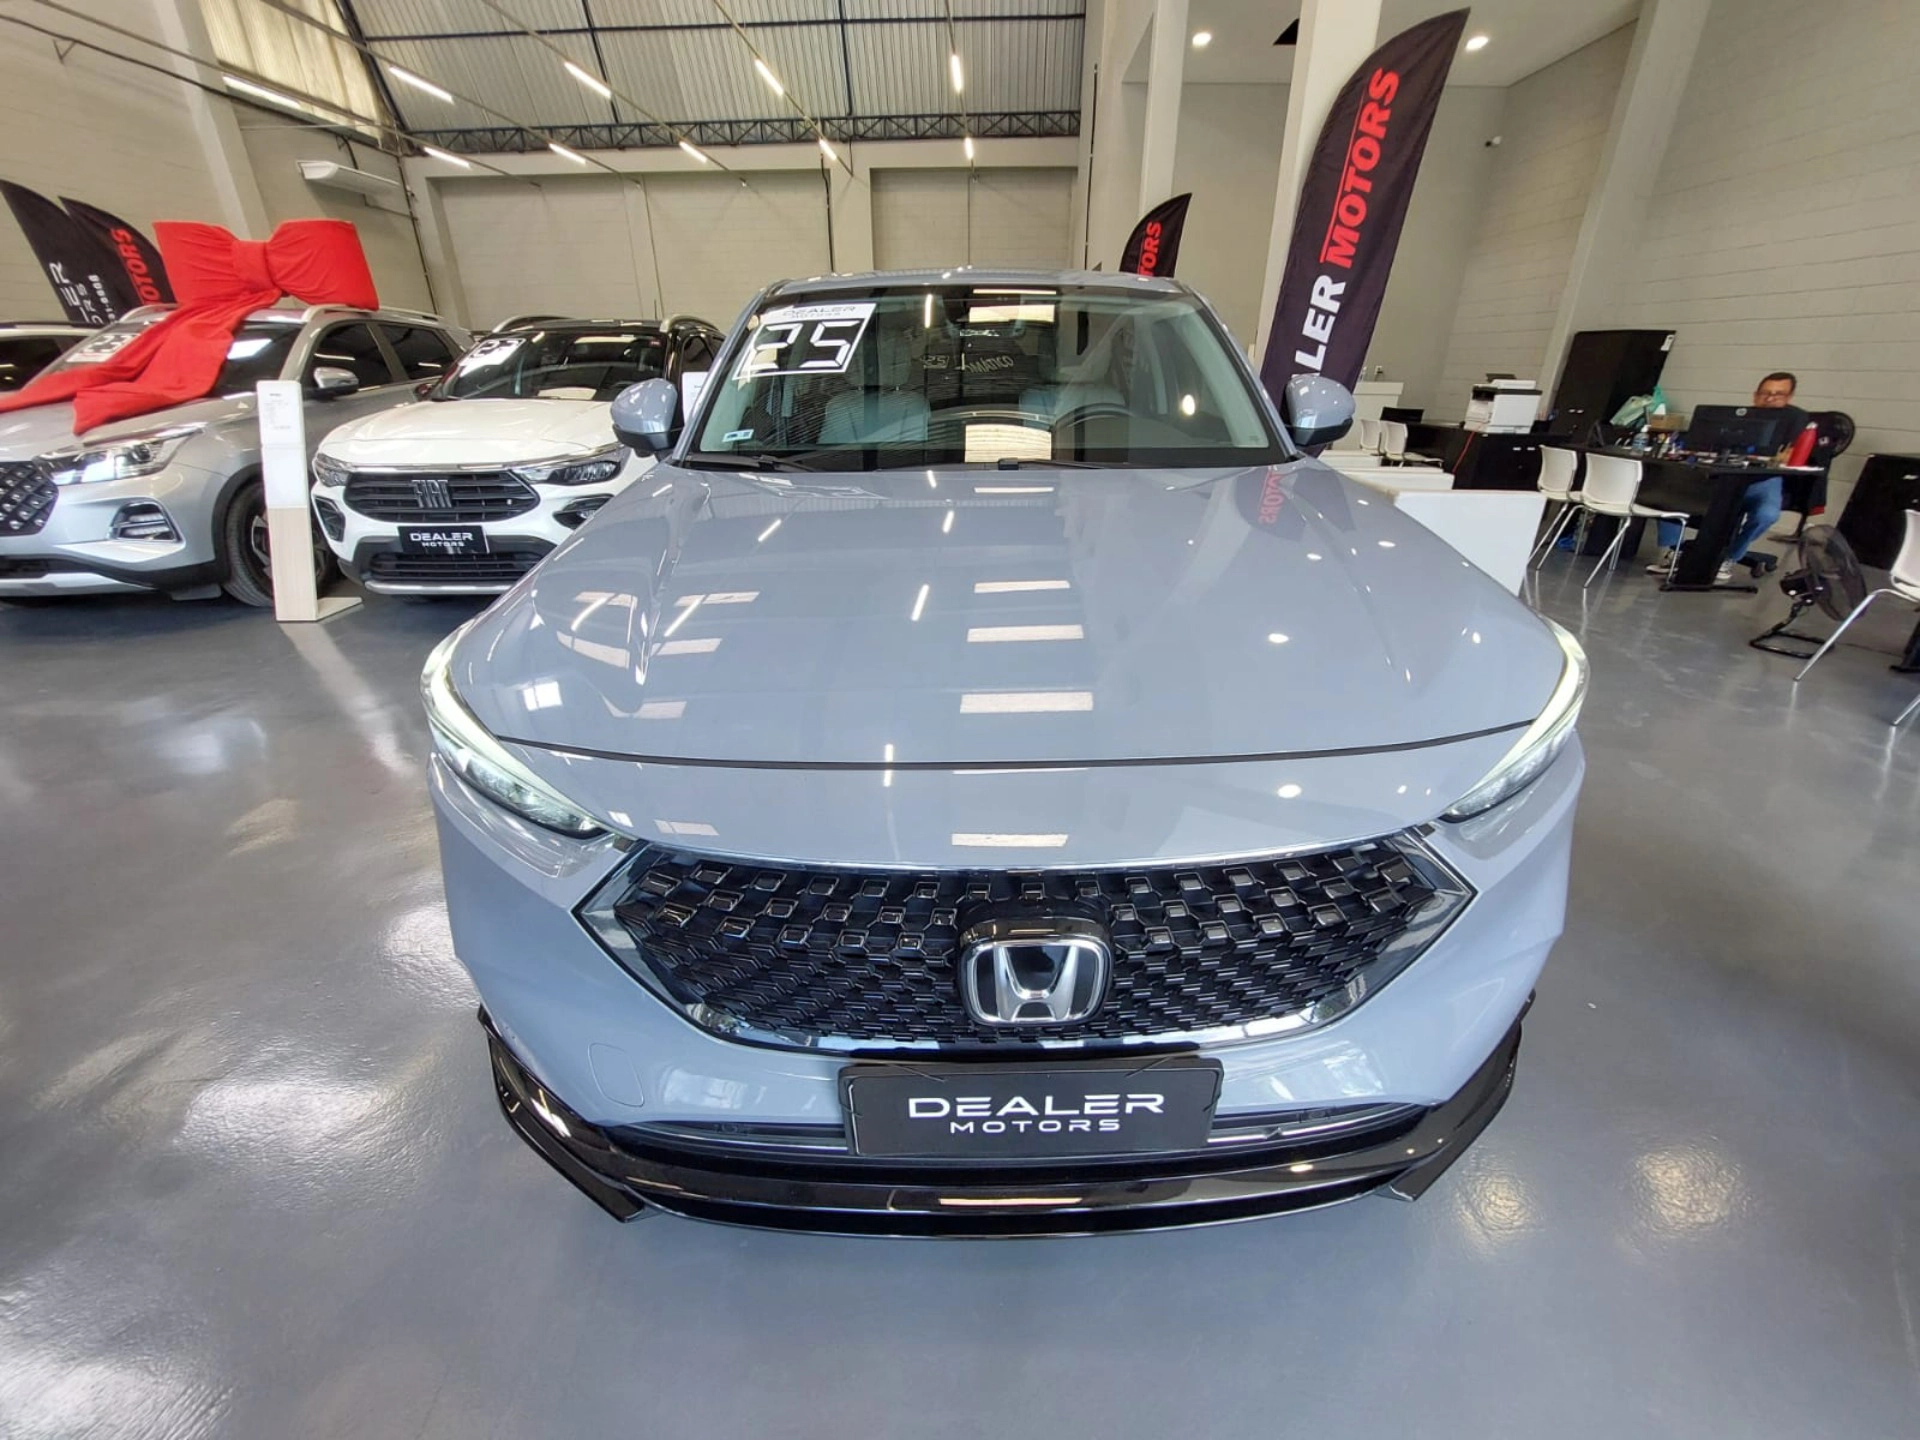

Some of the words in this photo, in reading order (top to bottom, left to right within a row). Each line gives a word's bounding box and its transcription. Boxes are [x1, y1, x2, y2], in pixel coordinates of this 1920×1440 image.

[1291, 274, 1346, 376] LER
[1325, 68, 1400, 268] MOTORS
[111, 228, 160, 304] OTORS
[748, 320, 861, 370] 25
[411, 479, 452, 508] FIAT
[409, 532, 474, 541] DEALER
[908, 1093, 1165, 1119] DEALER
[950, 1118, 1120, 1134] MOTORS
